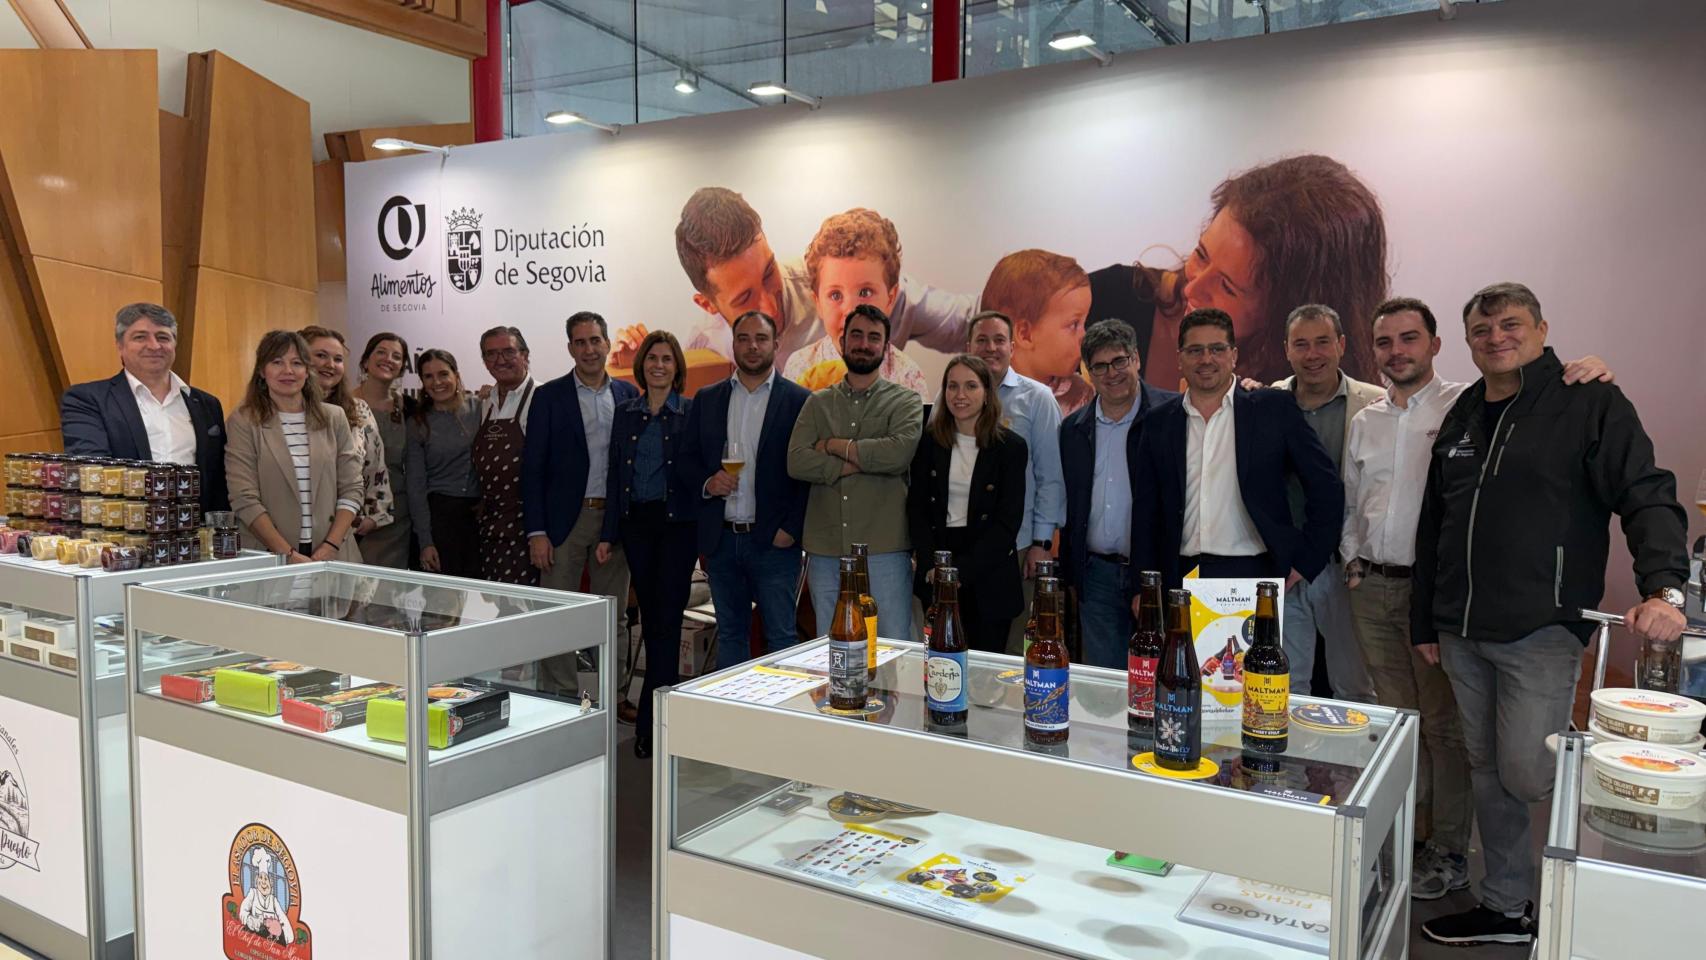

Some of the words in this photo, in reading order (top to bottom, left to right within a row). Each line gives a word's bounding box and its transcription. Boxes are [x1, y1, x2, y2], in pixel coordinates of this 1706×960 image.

[494, 222, 604, 258] Diputación
[370, 269, 437, 299] Alimentos
[494, 261, 519, 286] de
[526, 259, 607, 292] Segovia
[380, 304, 391, 312] DE
[392, 303, 427, 312] SEGOVIA
[1129, 668, 1155, 677] MALTM
[1248, 686, 1286, 695] MALTMAN
[1155, 702, 1193, 713] MALTMAN
[0, 830, 31, 859] Pueblo
[232, 872, 240, 886] EL
[262, 830, 274, 847] DE
[274, 843, 299, 907] SEGOVIA
[1241, 888, 1313, 910] FICHAS
[1211, 902, 1330, 934] CATÁLOGO
